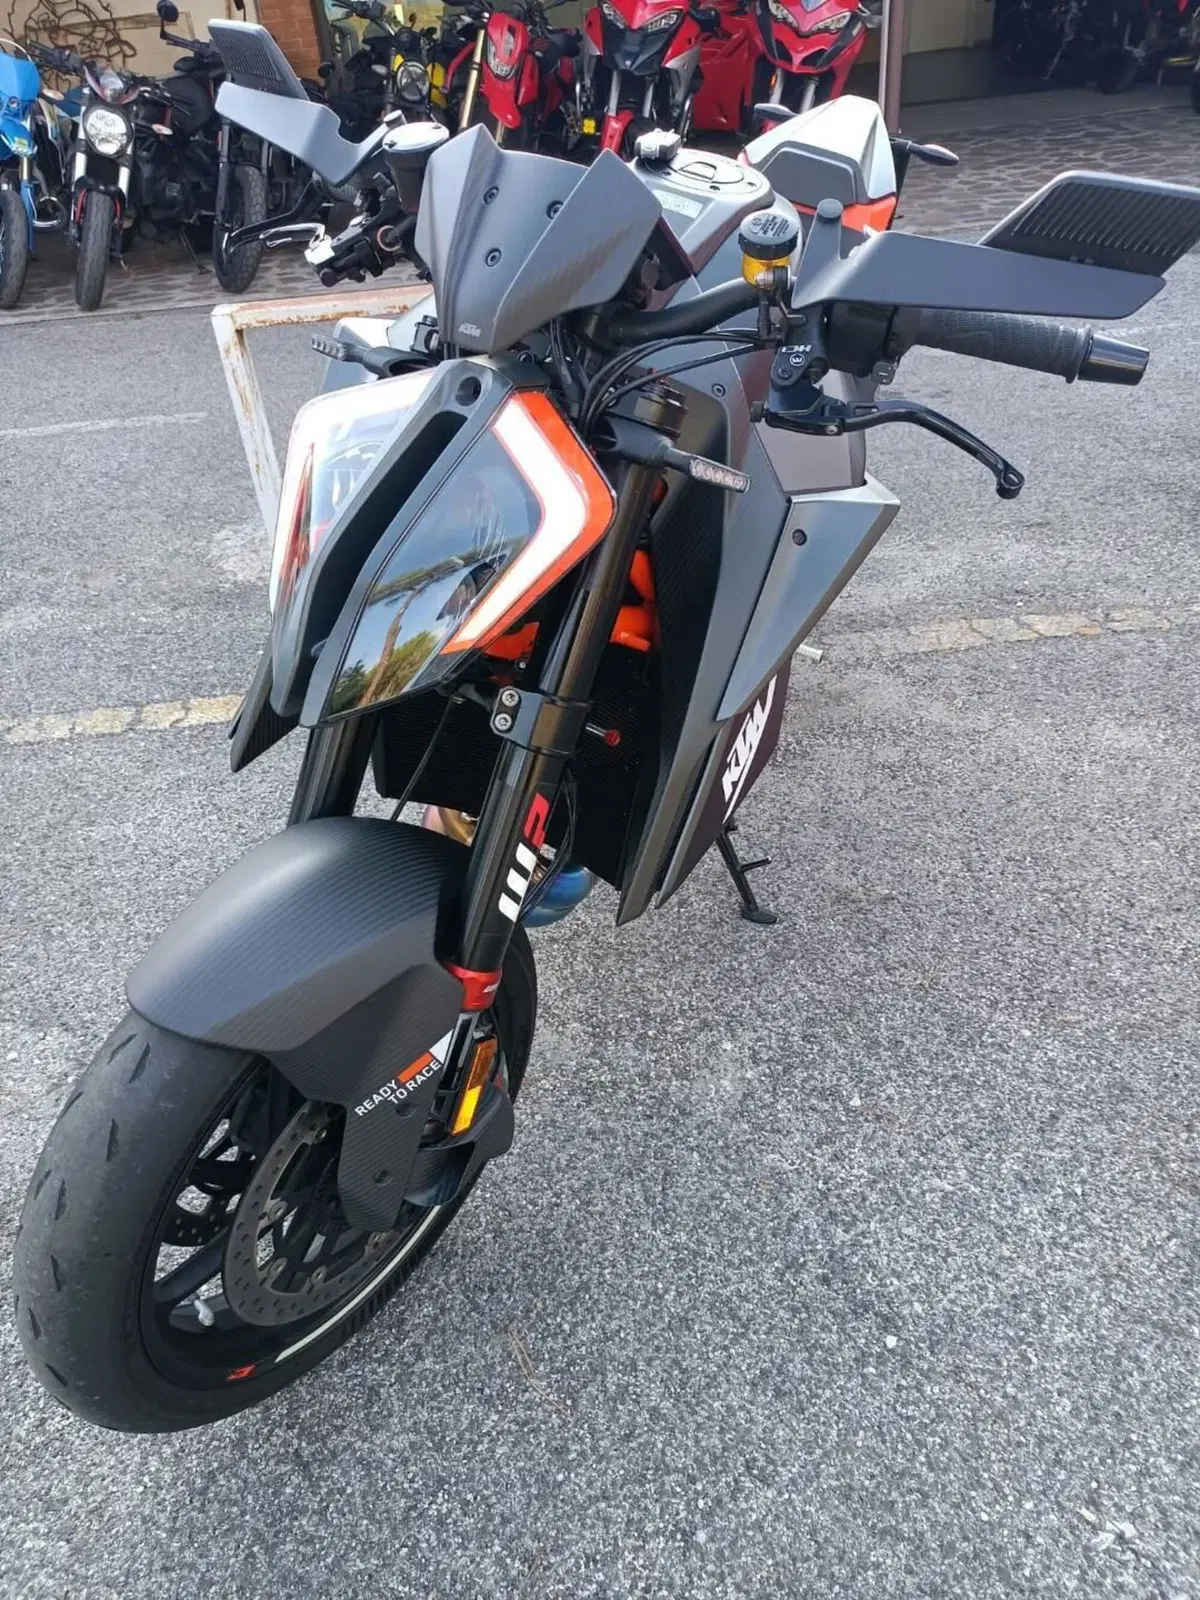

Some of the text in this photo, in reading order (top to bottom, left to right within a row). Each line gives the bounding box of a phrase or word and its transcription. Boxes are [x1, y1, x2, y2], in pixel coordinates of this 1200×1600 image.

[722, 674, 778, 824] KTM
[354, 1079, 399, 1116] READY
[387, 1060, 442, 1104] TO RACE
